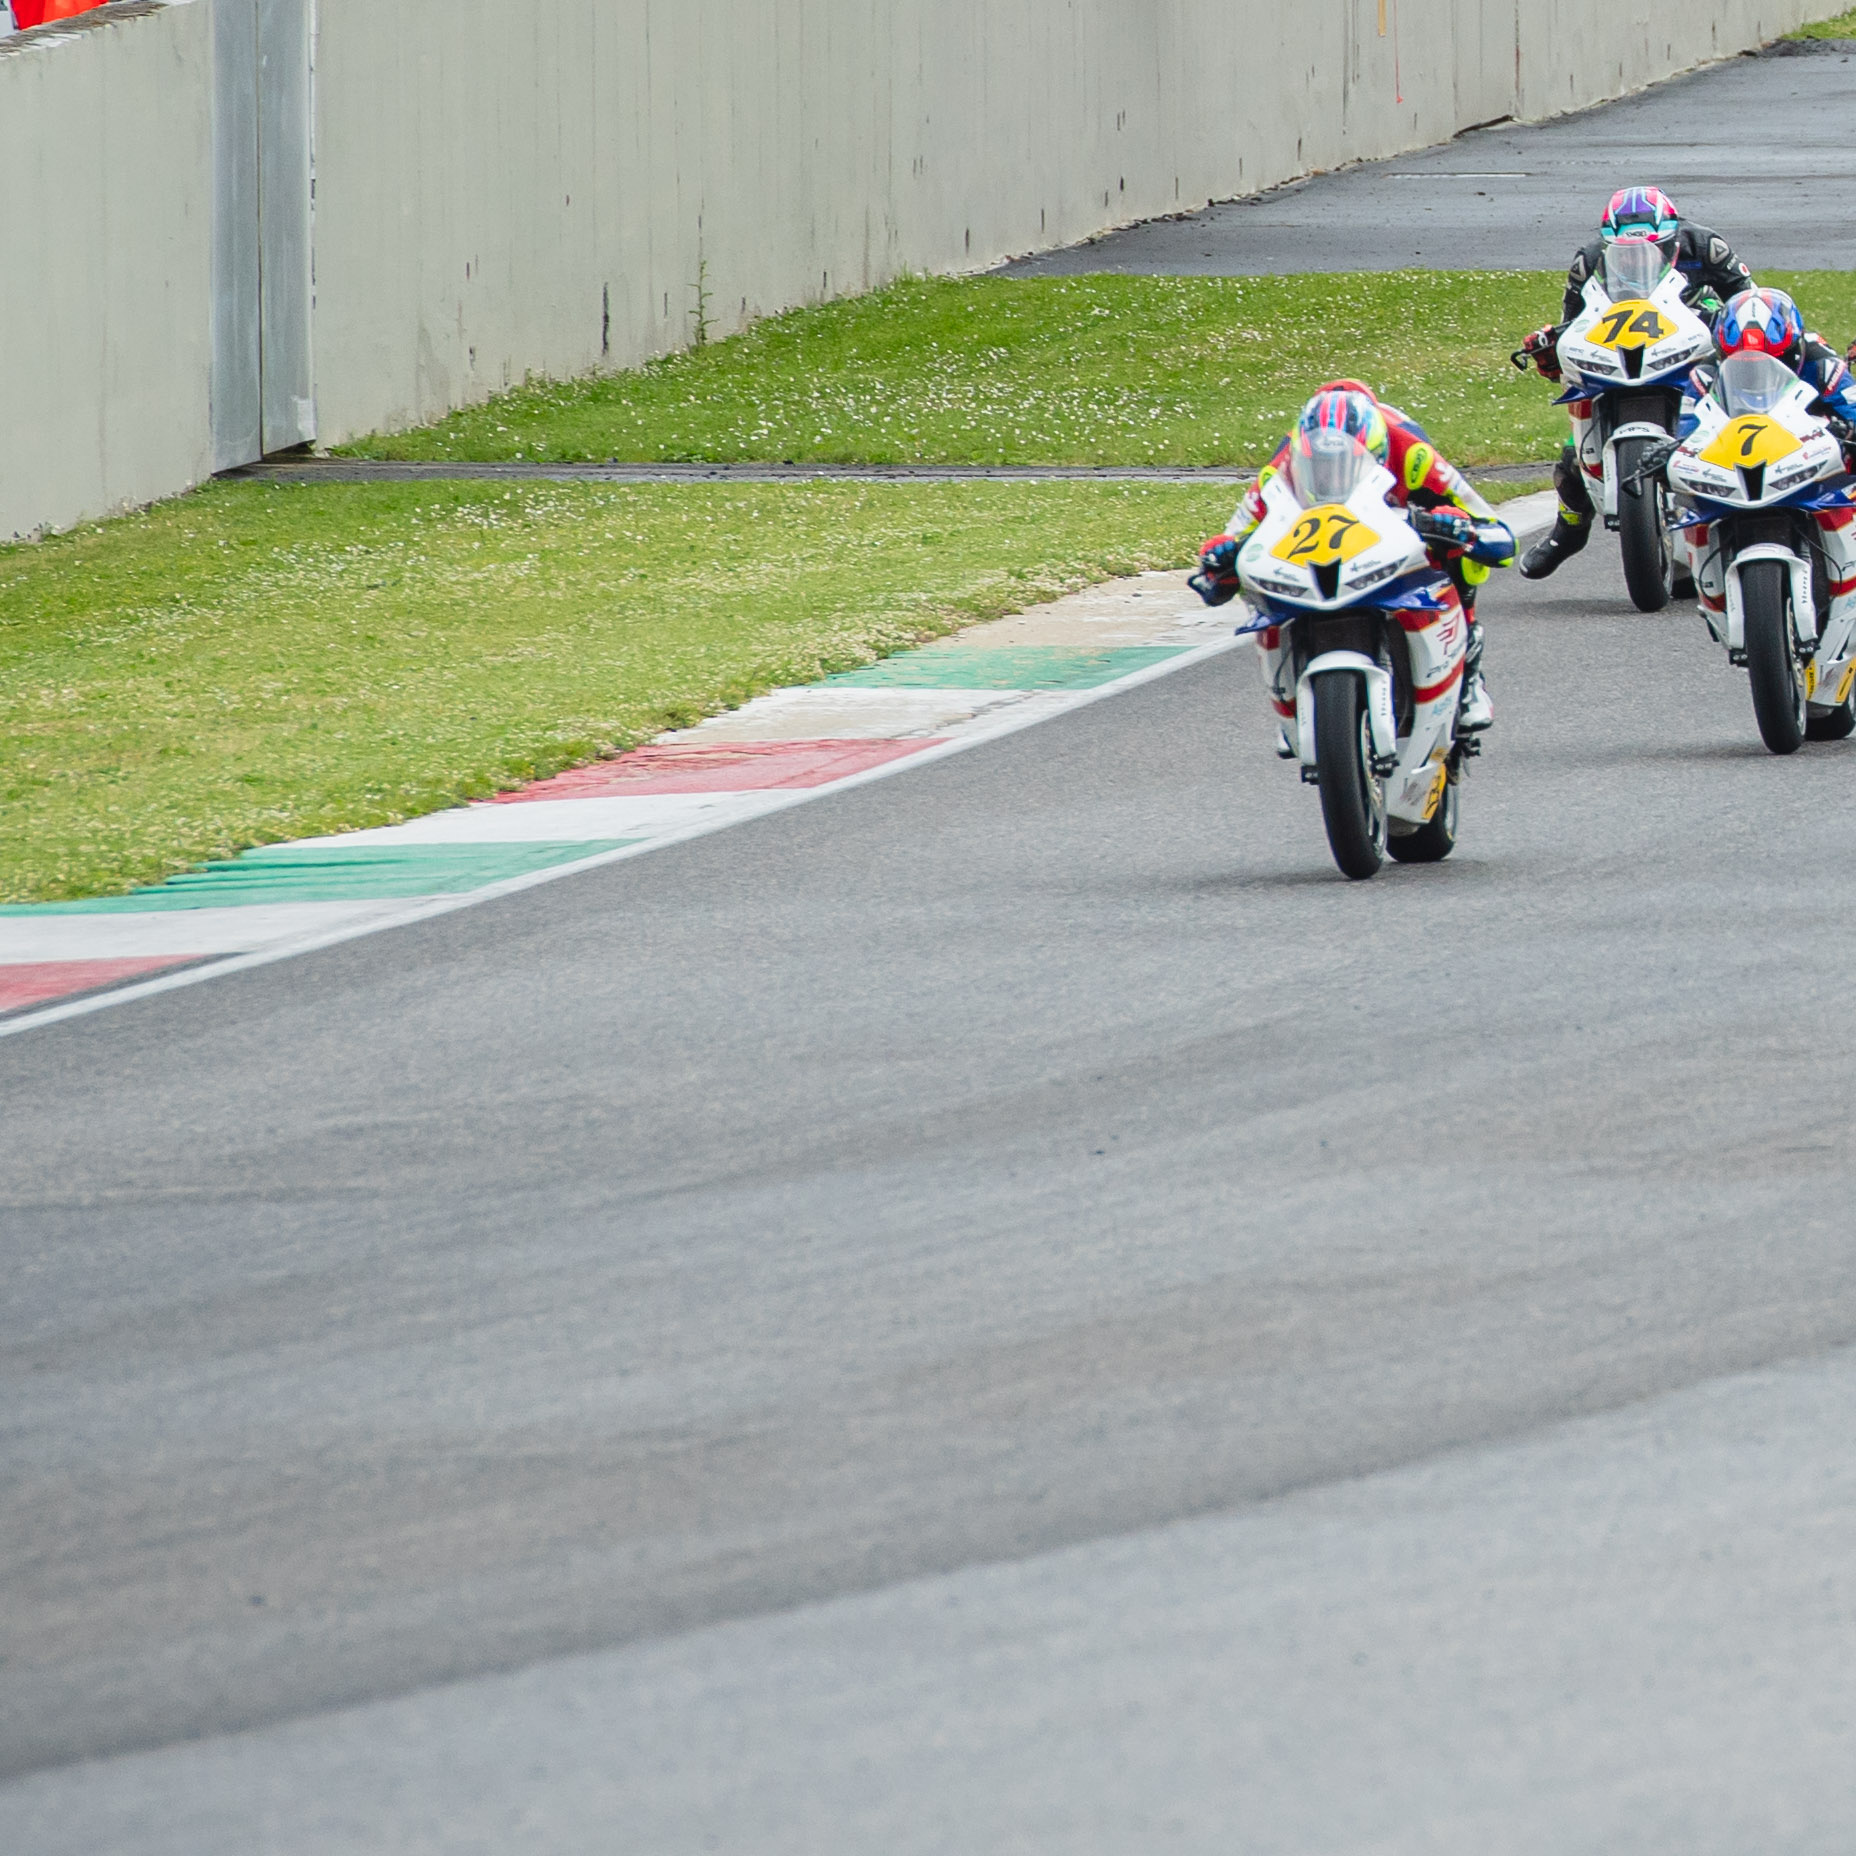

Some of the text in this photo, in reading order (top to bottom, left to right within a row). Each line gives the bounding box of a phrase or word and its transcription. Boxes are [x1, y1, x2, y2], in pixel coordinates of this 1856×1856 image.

[1602, 309, 1665, 344] 74
[1737, 423, 1769, 456] 7
[1286, 514, 1360, 560] 27
